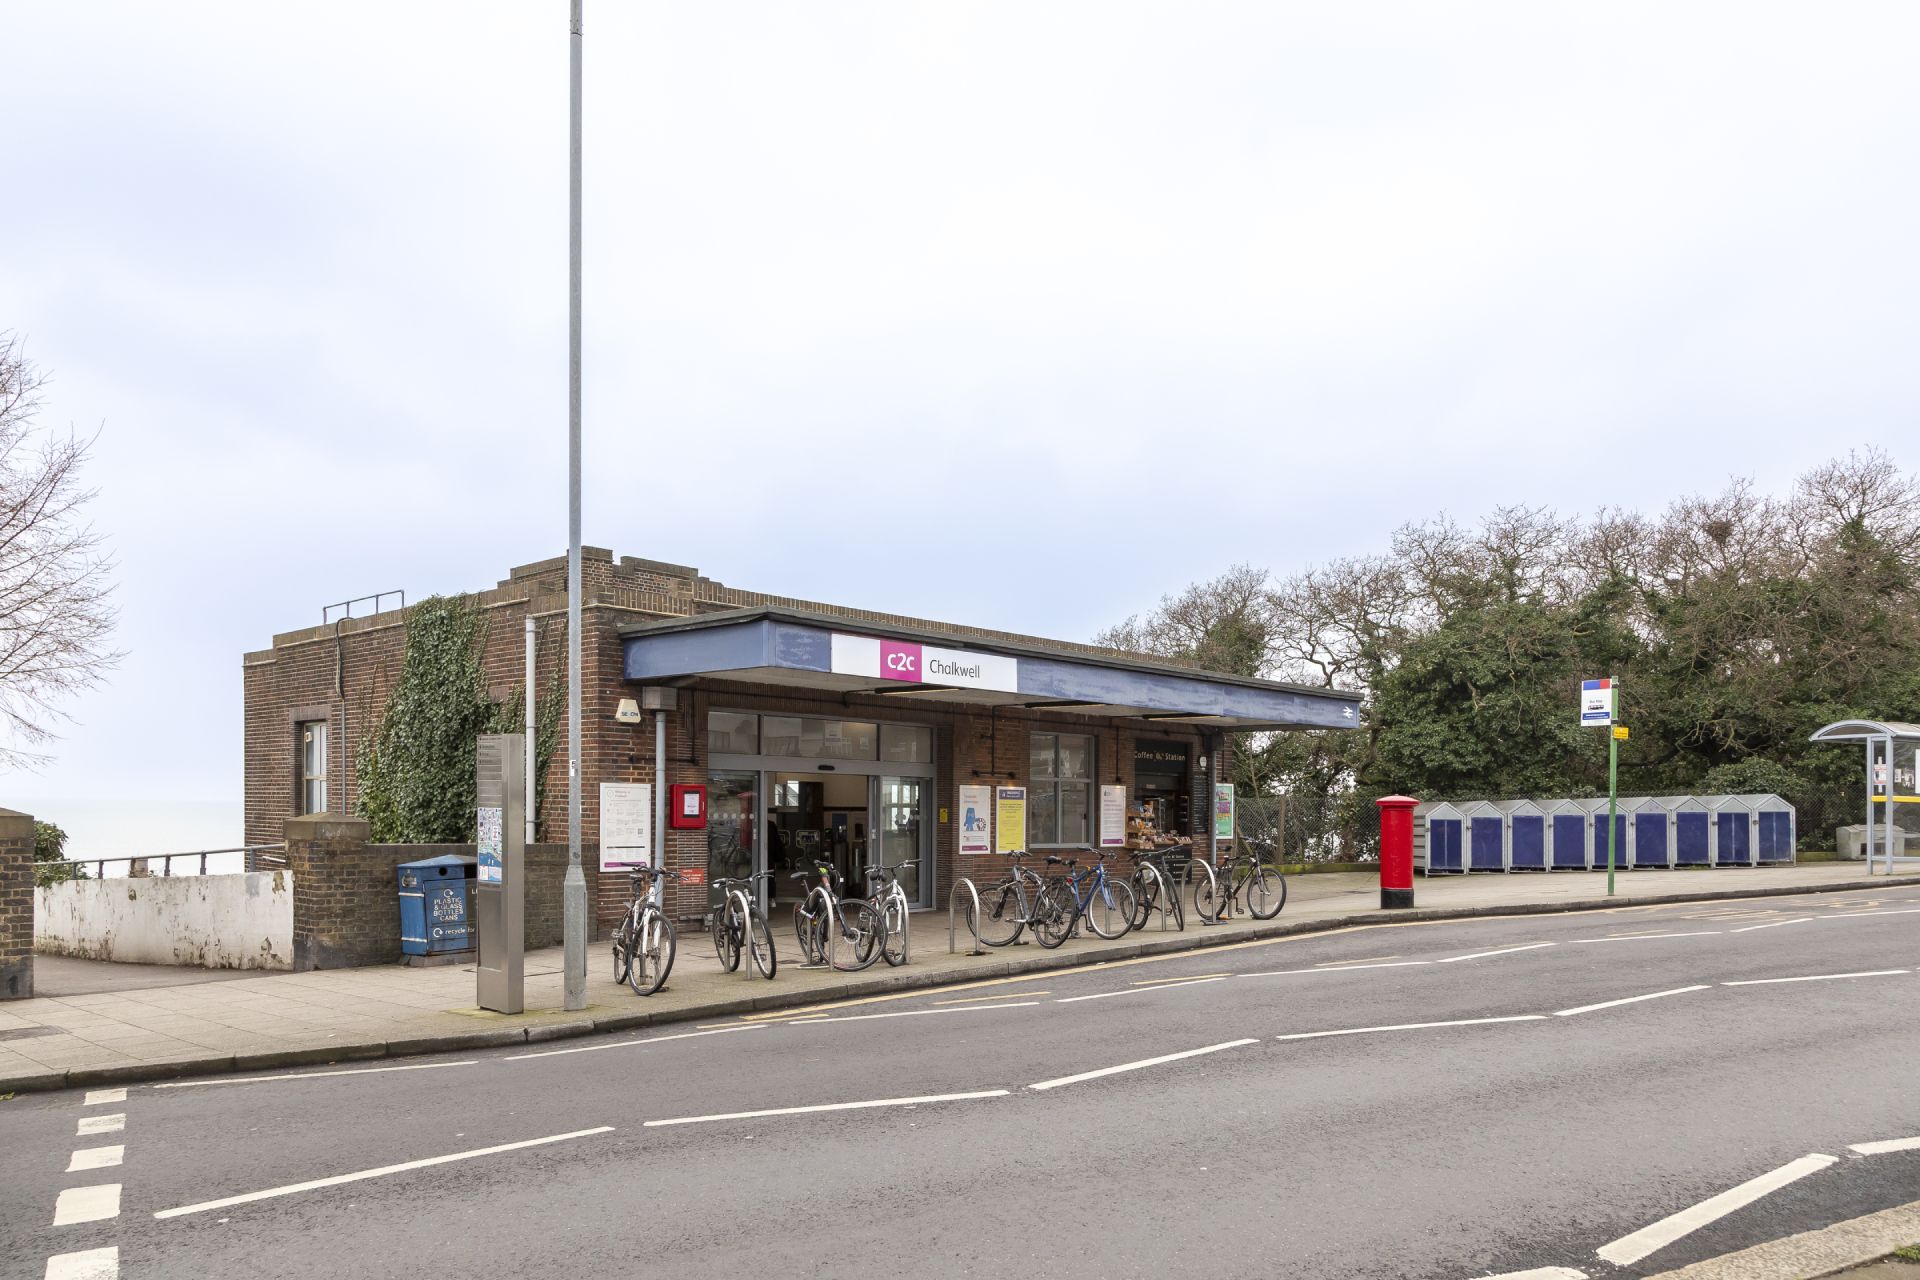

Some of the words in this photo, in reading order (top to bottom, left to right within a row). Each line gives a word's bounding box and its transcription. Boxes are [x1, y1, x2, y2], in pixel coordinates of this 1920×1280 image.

[929, 659, 980, 678] Chalkwell
[1165, 752, 1186, 761] Station
[434, 897, 461, 905] PLASTIC
[441, 901, 462, 910] GLASS
[433, 908, 463, 917] BOTTLES
[445, 927, 465, 935] recycle
